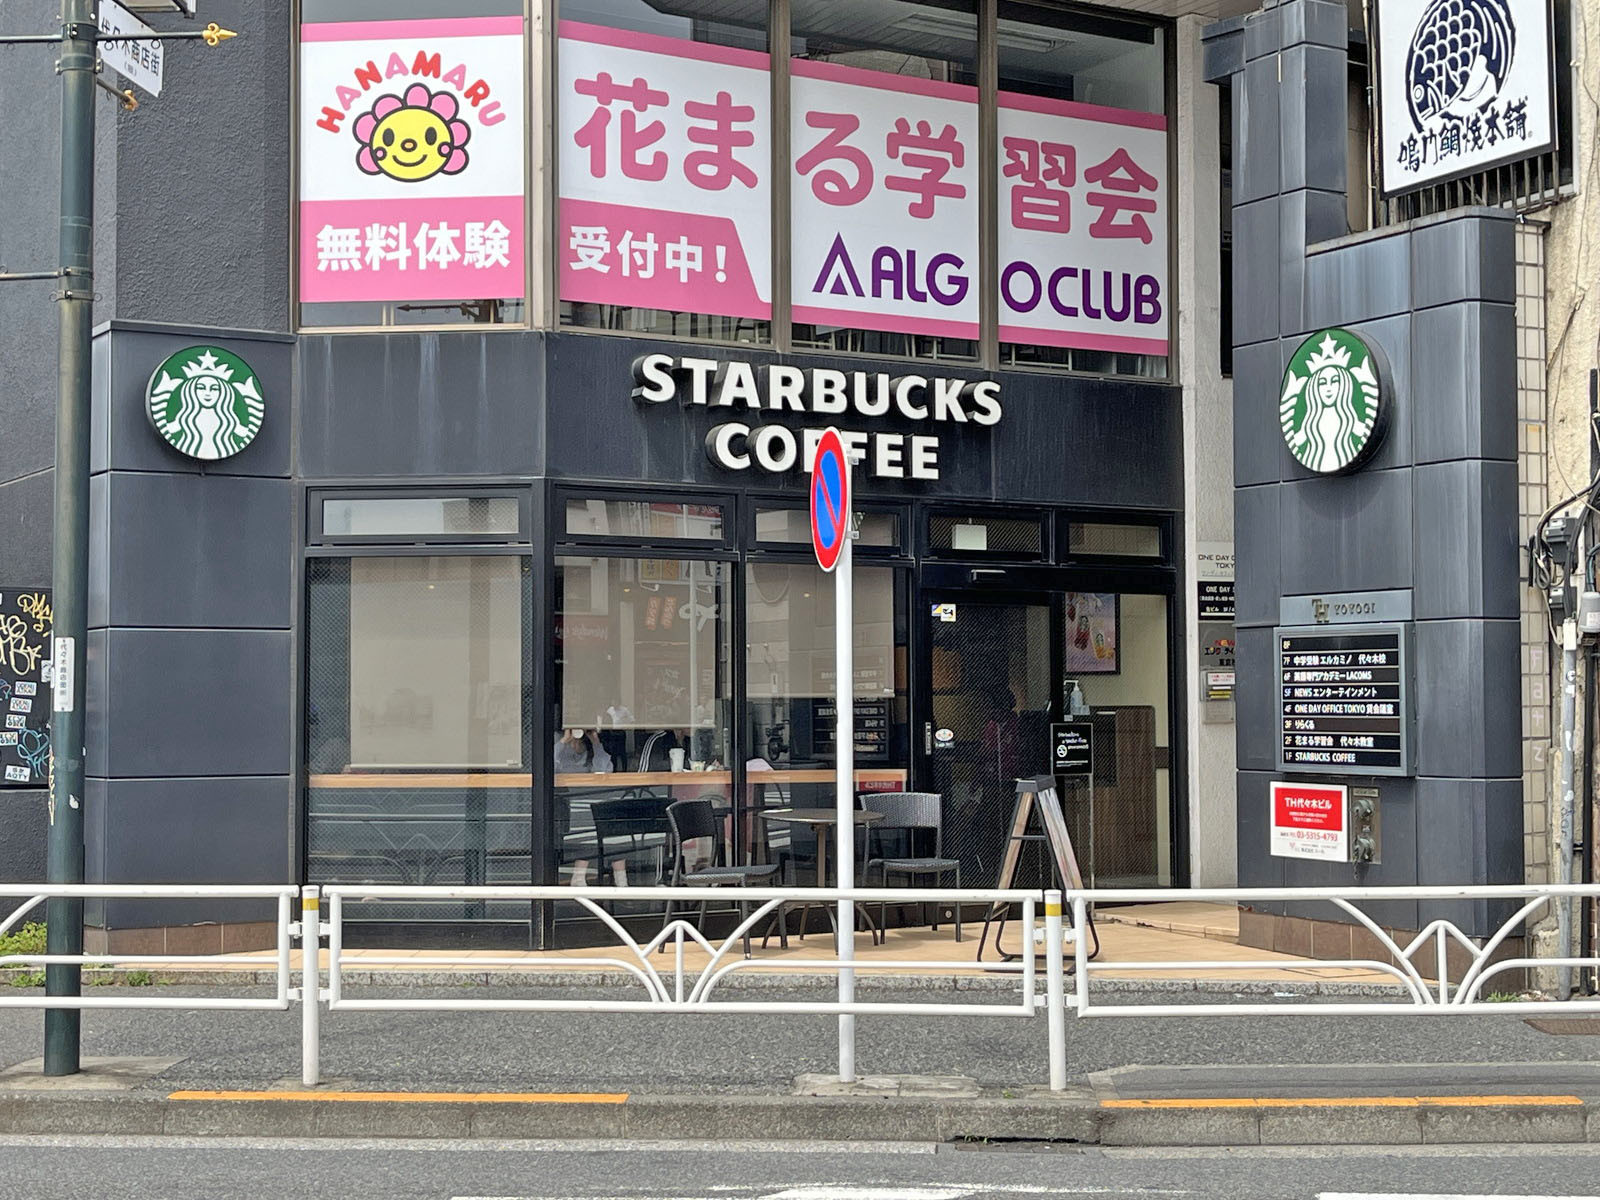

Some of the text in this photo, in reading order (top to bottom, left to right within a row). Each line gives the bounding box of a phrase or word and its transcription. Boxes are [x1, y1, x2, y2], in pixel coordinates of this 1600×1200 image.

[316, 50, 506, 133] HANAMARU
[316, 219, 511, 272] 無料体験
[640, 354, 1002, 426] STARBUCKS
[715, 422, 940, 481] COFFEE
[1334, 603, 1376, 616] YOYOGI
[1294, 704, 1308, 713] ONE
[1308, 704, 1321, 713] DAY
[1322, 704, 1343, 714] OFFICE
[1285, 751, 1356, 763] 1F STARBUCKS COFFEE
